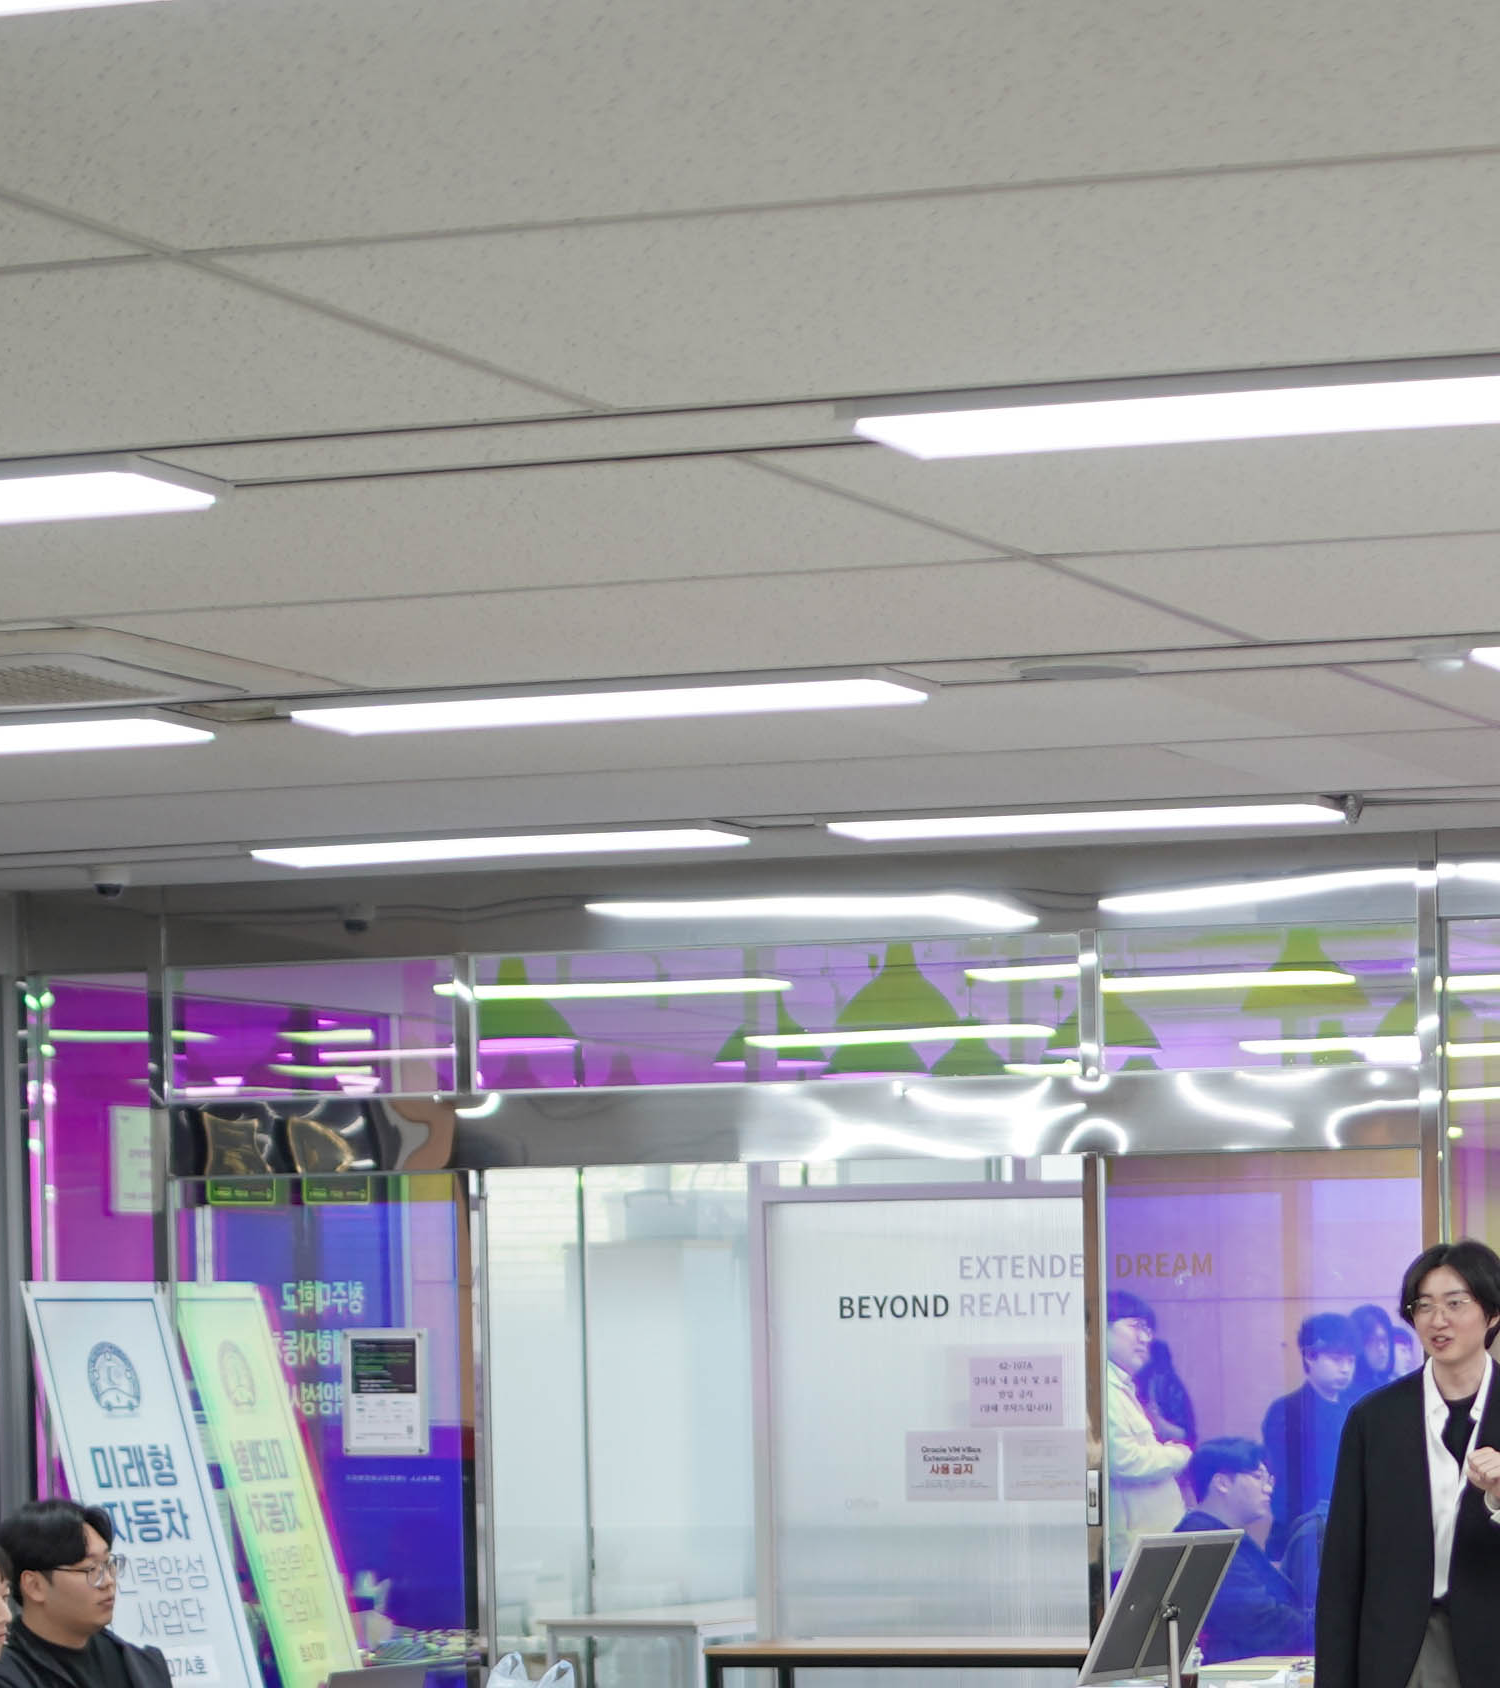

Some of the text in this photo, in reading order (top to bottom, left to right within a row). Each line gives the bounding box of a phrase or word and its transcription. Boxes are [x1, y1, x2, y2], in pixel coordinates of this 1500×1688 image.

[959, 1252, 1213, 1280] EXTENDE DREAM
[839, 1291, 1071, 1319] BEYOND REALITY
[90, 1444, 178, 1489] 미래형
[103, 1498, 190, 1544] 자동차
[138, 1598, 208, 1637] 사업단
